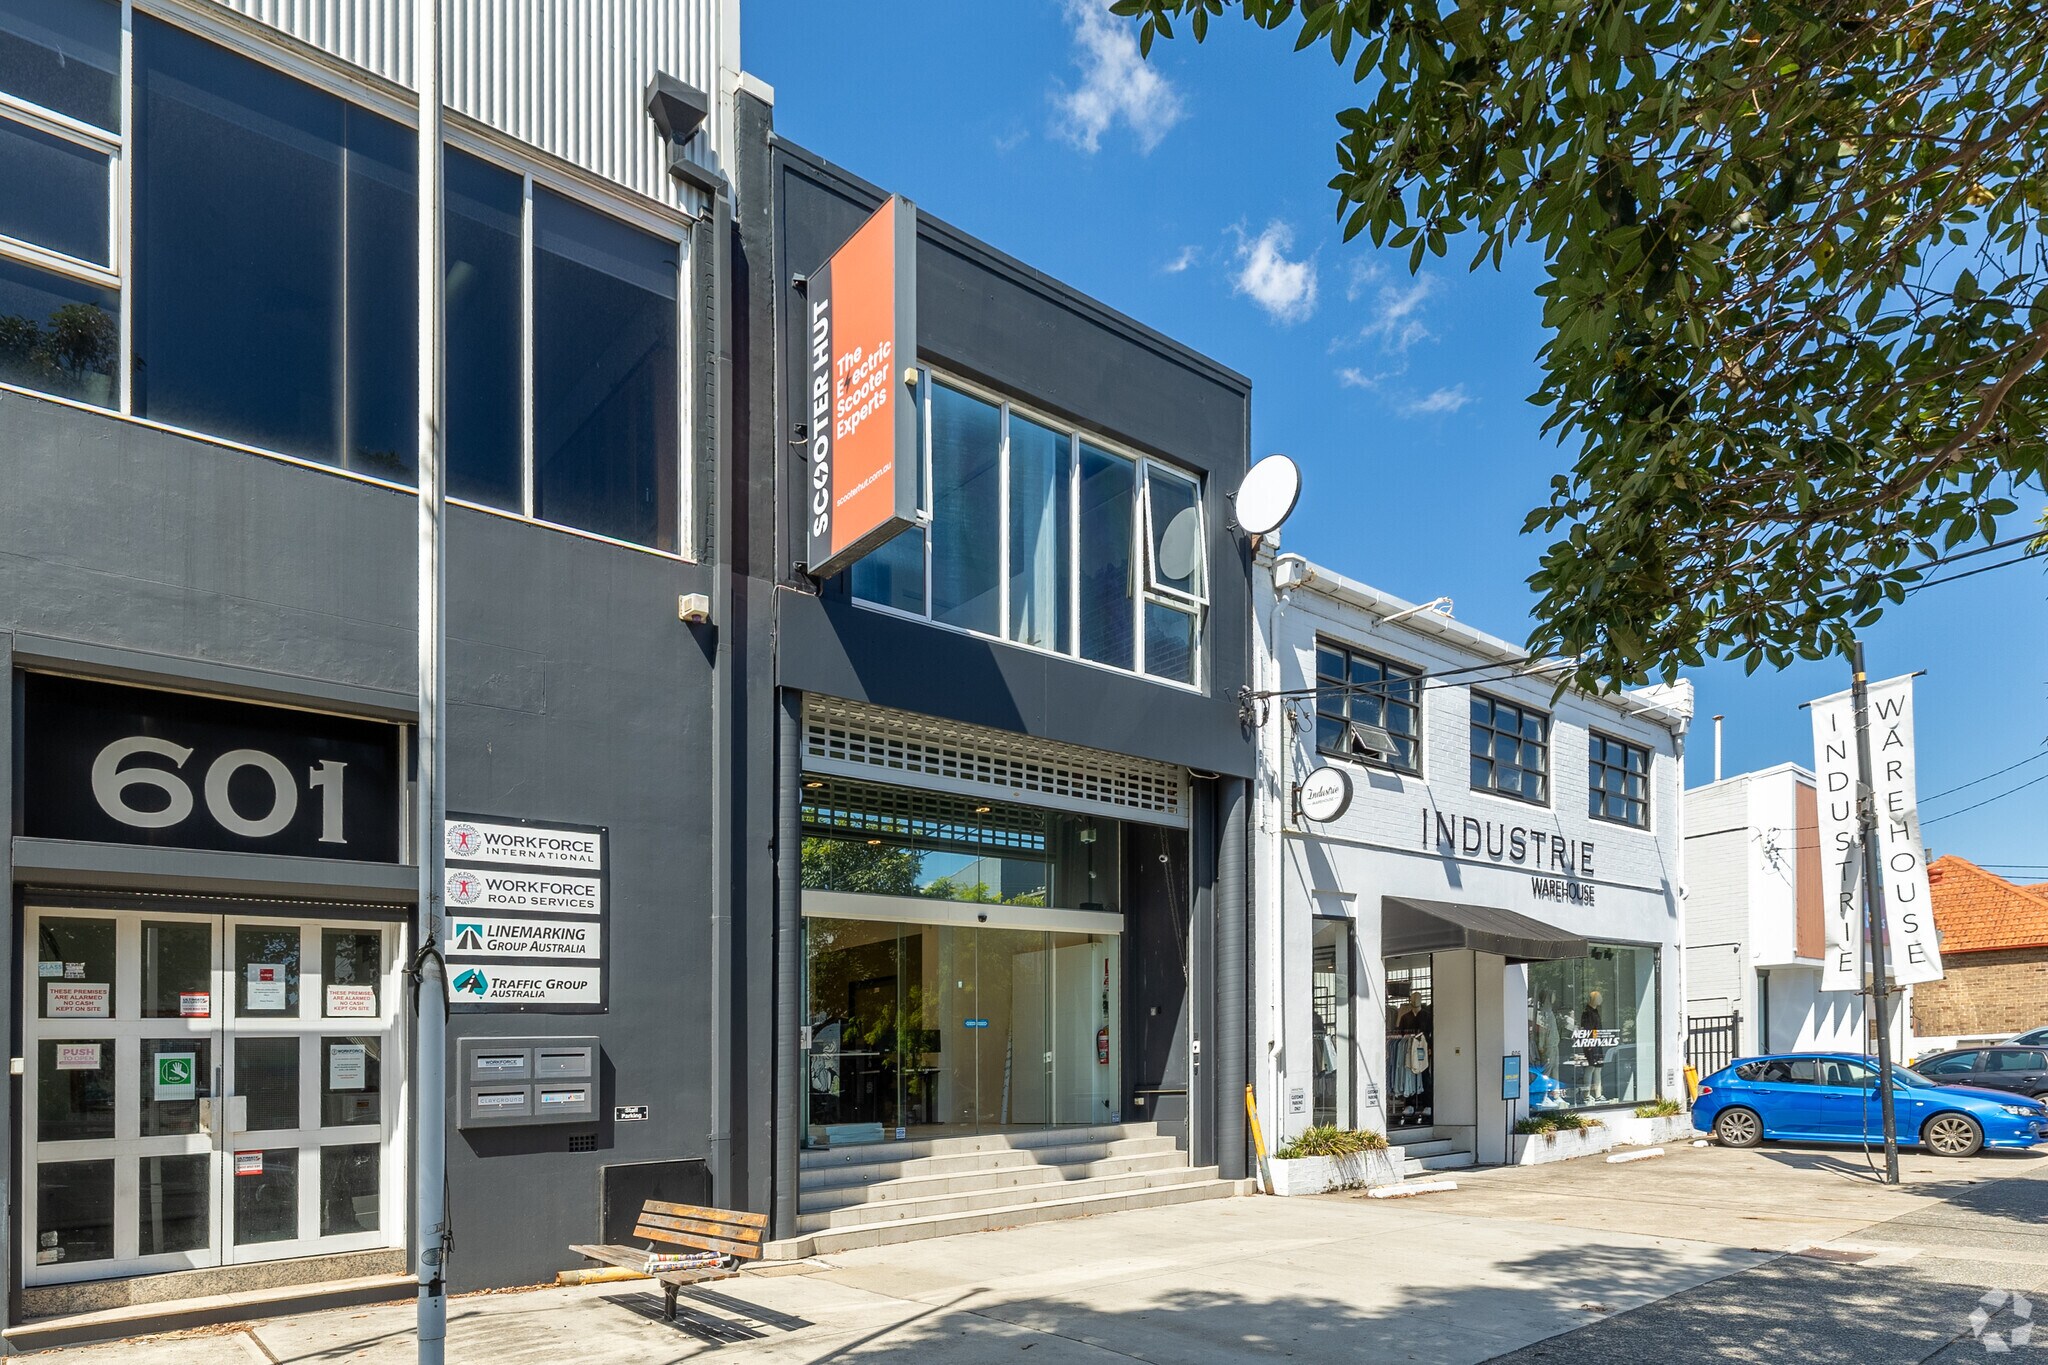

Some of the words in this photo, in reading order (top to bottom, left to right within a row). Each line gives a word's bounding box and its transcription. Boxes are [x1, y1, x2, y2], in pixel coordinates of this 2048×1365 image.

[813, 299, 829, 372] HUT
[837, 346, 862, 377] The
[837, 363, 889, 418] Scooter
[837, 388, 887, 440] Experts
[813, 370, 829, 537] SCOOTER
[836, 462, 892, 507] scooterhut.com.au
[91, 735, 348, 844] 601
[1307, 785, 1340, 800] Industrie
[1875, 694, 1926, 965] WAREHOUSE
[484, 833, 594, 853] WORKFORCE
[1422, 808, 1594, 875] INDUSTRIE
[1825, 713, 1854, 973] INDUSTRIE
[486, 847, 594, 863] INTERNATIONAL
[485, 878, 596, 897] WORKFORCE
[1531, 877, 1595, 901] WAREHOUSE
[488, 894, 527, 904] ROAD
[530, 896, 595, 909] SERVICES
[487, 925, 586, 940] LINEMARKING
[487, 939, 528, 951] GROUP
[529, 940, 586, 953] AUSTRALIA
[490, 990, 546, 998] AUSTRALIA
[491, 978, 543, 989] TRAFFIC
[545, 979, 588, 990] GROUP
[1571, 1029, 1593, 1039] NEW
[1571, 1037, 1620, 1048] ARRIVALS
